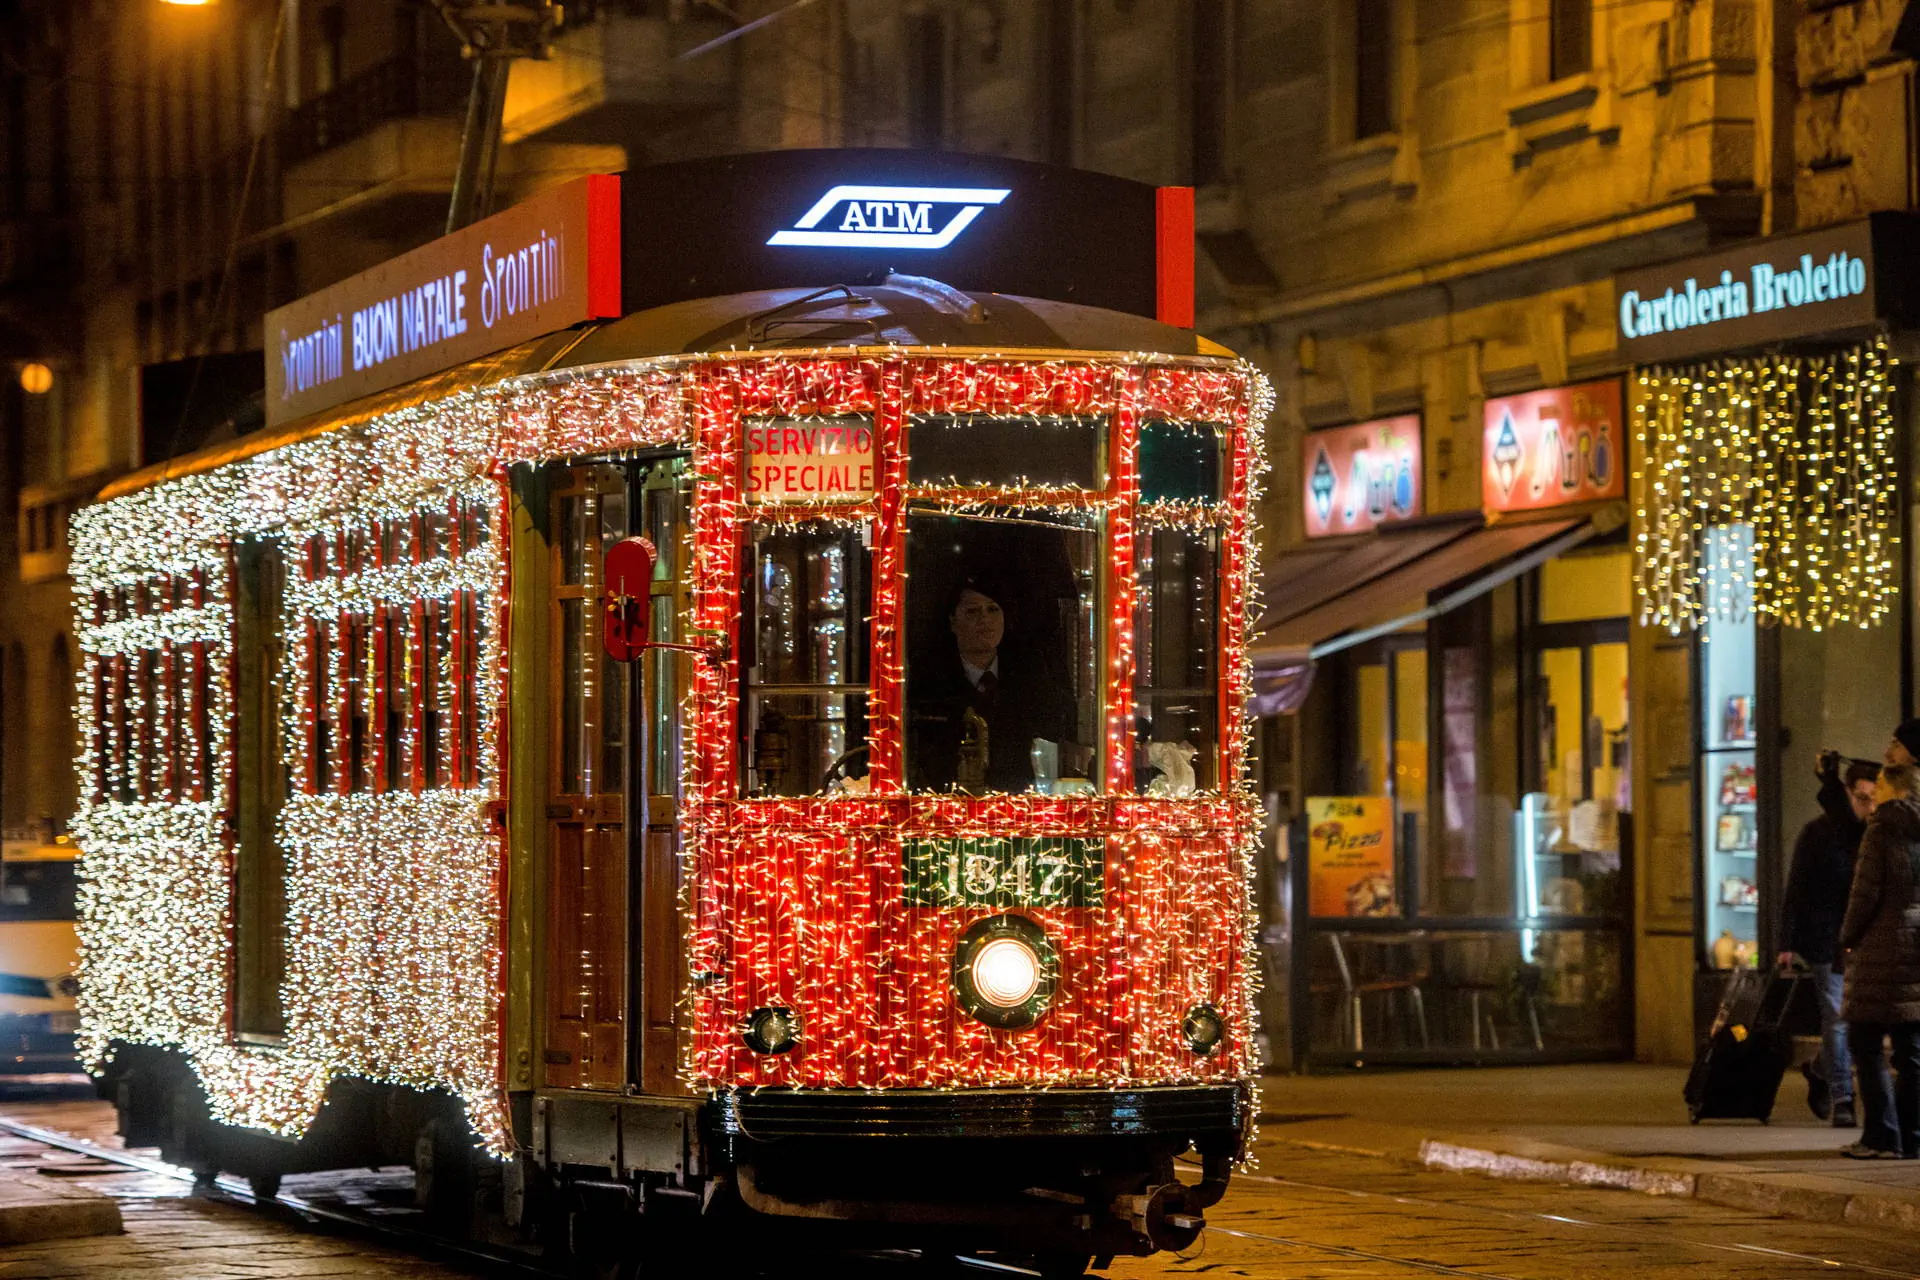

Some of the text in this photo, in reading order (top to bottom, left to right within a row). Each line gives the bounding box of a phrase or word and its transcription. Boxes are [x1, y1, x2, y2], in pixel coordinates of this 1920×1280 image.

[839, 201, 933, 234] ATM
[1620, 251, 1867, 339] Cartoleria Broletto
[352, 296, 399, 372] BUON
[402, 269, 468, 354] NATALE
[749, 427, 873, 456] SERVIZIO
[747, 464, 874, 493] SPECIALE
[948, 854, 1069, 897] 1847
